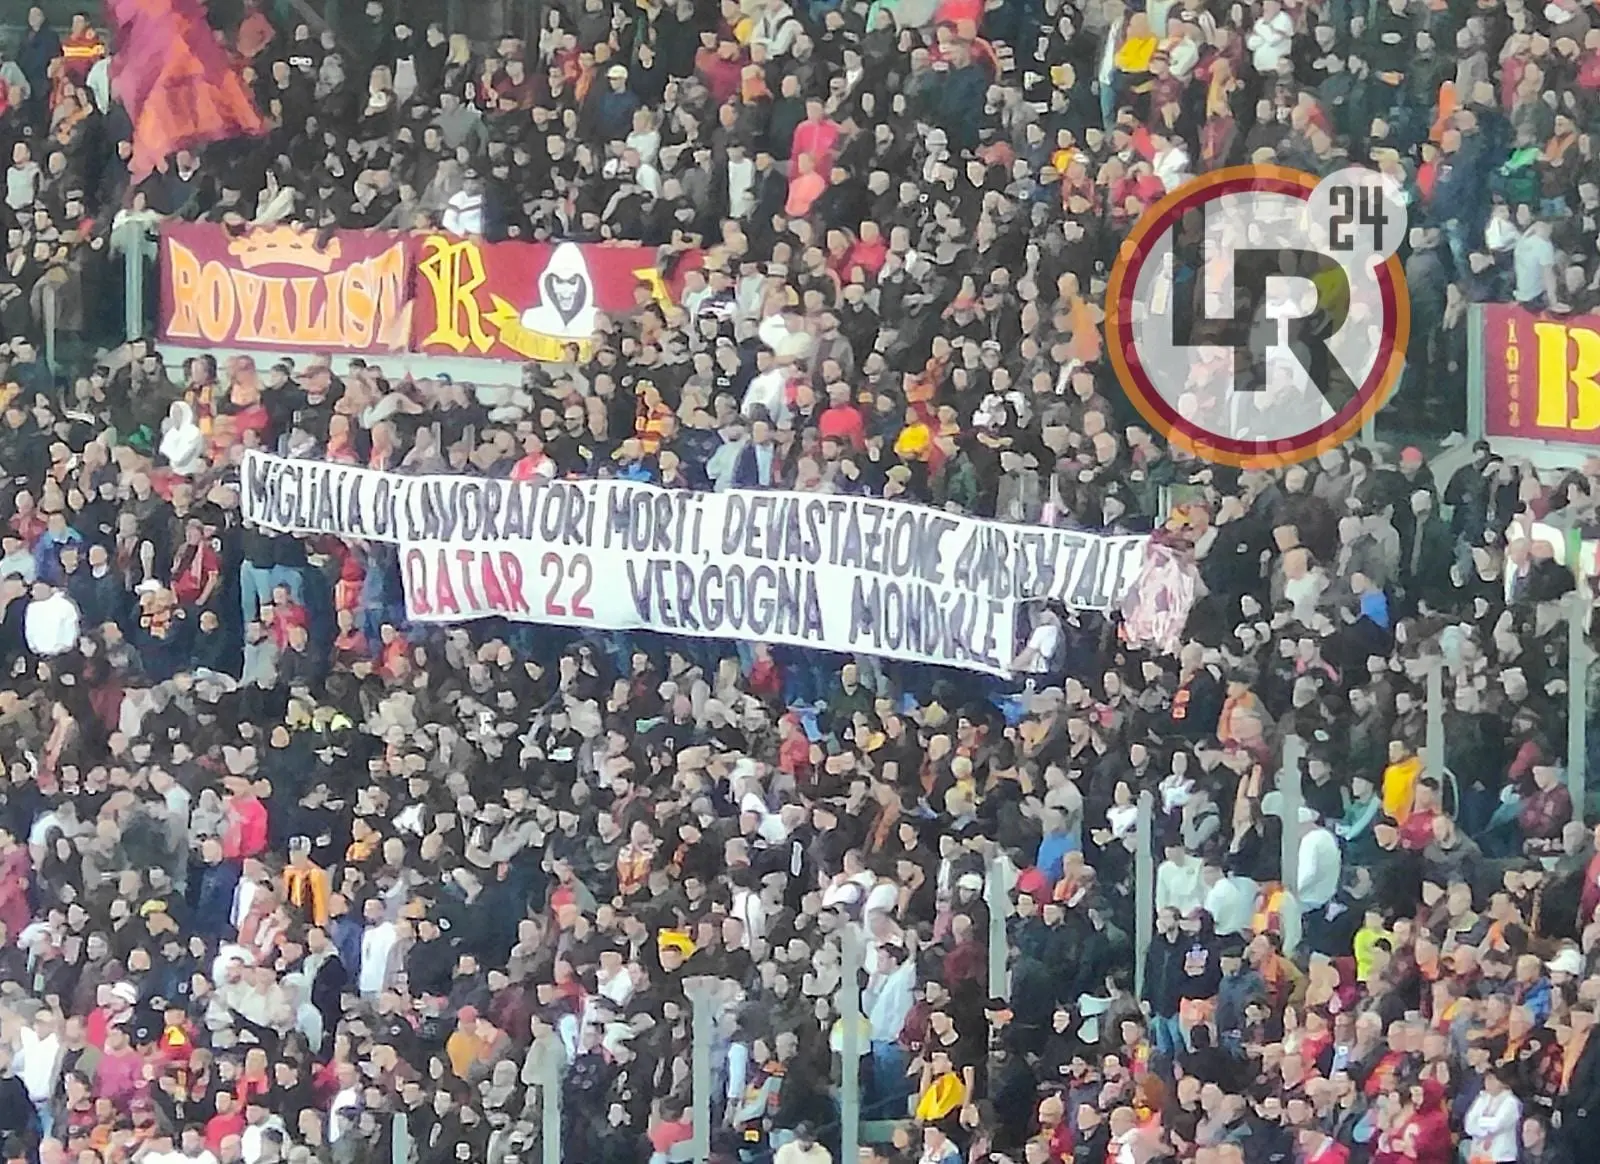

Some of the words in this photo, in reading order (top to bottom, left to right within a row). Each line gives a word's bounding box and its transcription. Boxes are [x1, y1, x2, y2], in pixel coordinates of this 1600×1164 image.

[166, 237, 410, 348] ROYALIST
[405, 548, 531, 615] QATAR
[541, 551, 596, 619] 22
[626, 559, 825, 641] VERGOGNA
